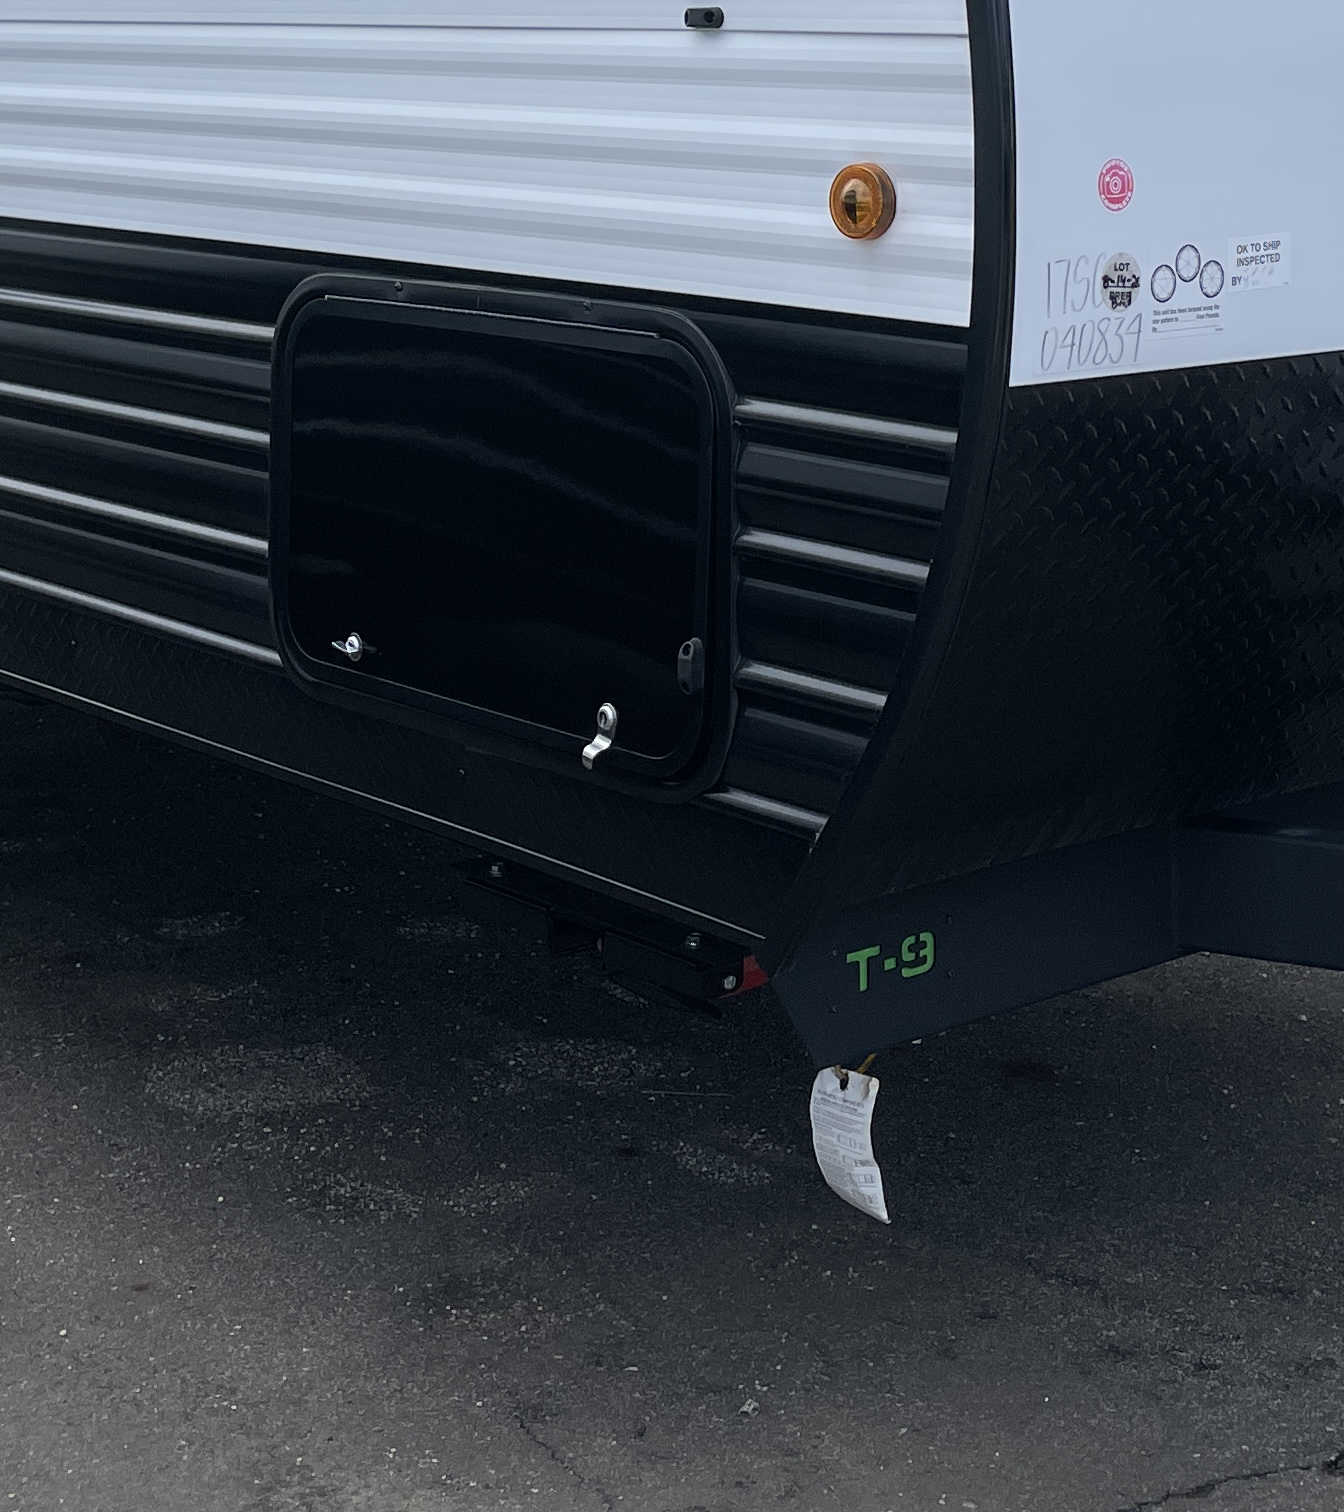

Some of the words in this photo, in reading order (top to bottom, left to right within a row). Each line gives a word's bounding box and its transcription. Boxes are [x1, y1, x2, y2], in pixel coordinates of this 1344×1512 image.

[1236, 244, 1248, 254] OK
[1250, 242, 1261, 252] TO
[1236, 253, 1281, 267] INSPECTED
[1113, 262, 1130, 272] LOT
[1231, 276, 1242, 287] BY
